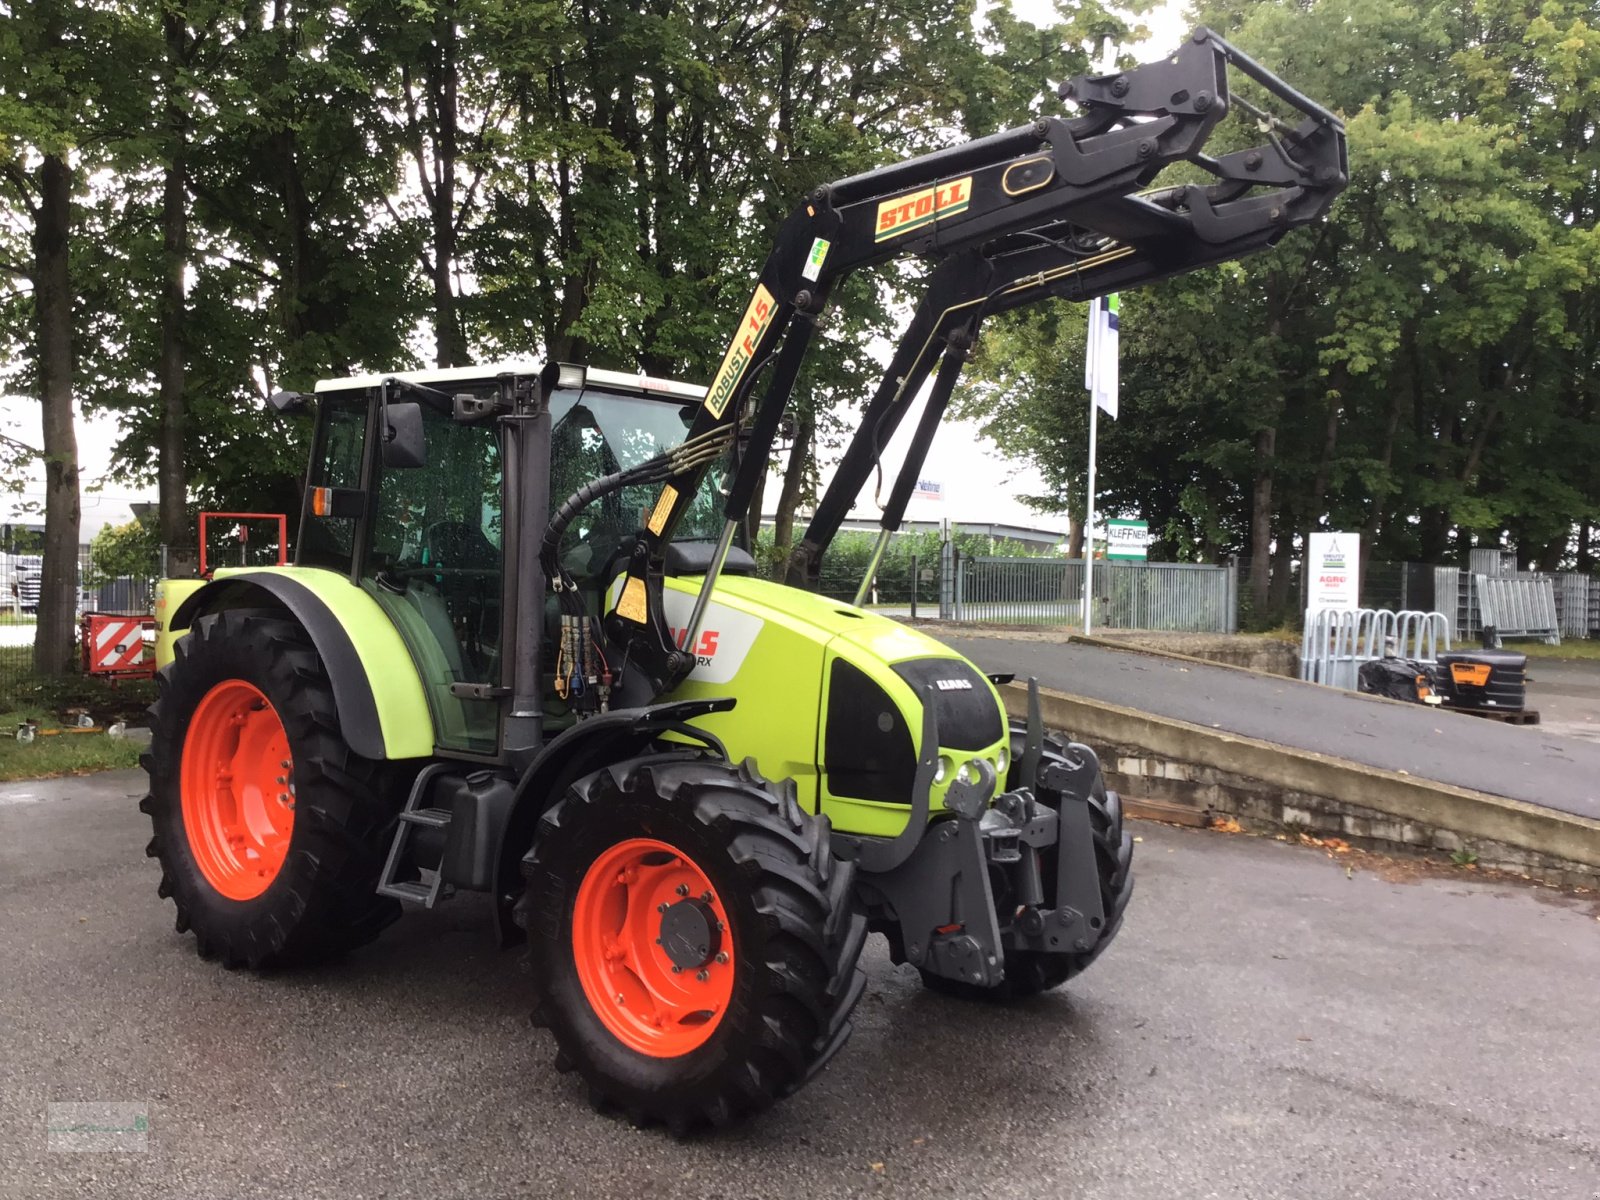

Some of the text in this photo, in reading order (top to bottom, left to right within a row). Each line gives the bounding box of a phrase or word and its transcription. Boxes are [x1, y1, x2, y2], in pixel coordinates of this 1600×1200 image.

[880, 183, 965, 231] STOLL
[710, 346, 745, 410] ROBUST
[749, 299, 769, 332] 15
[1109, 528, 1147, 540] KLEFFNER
[696, 656, 712, 667] RX
